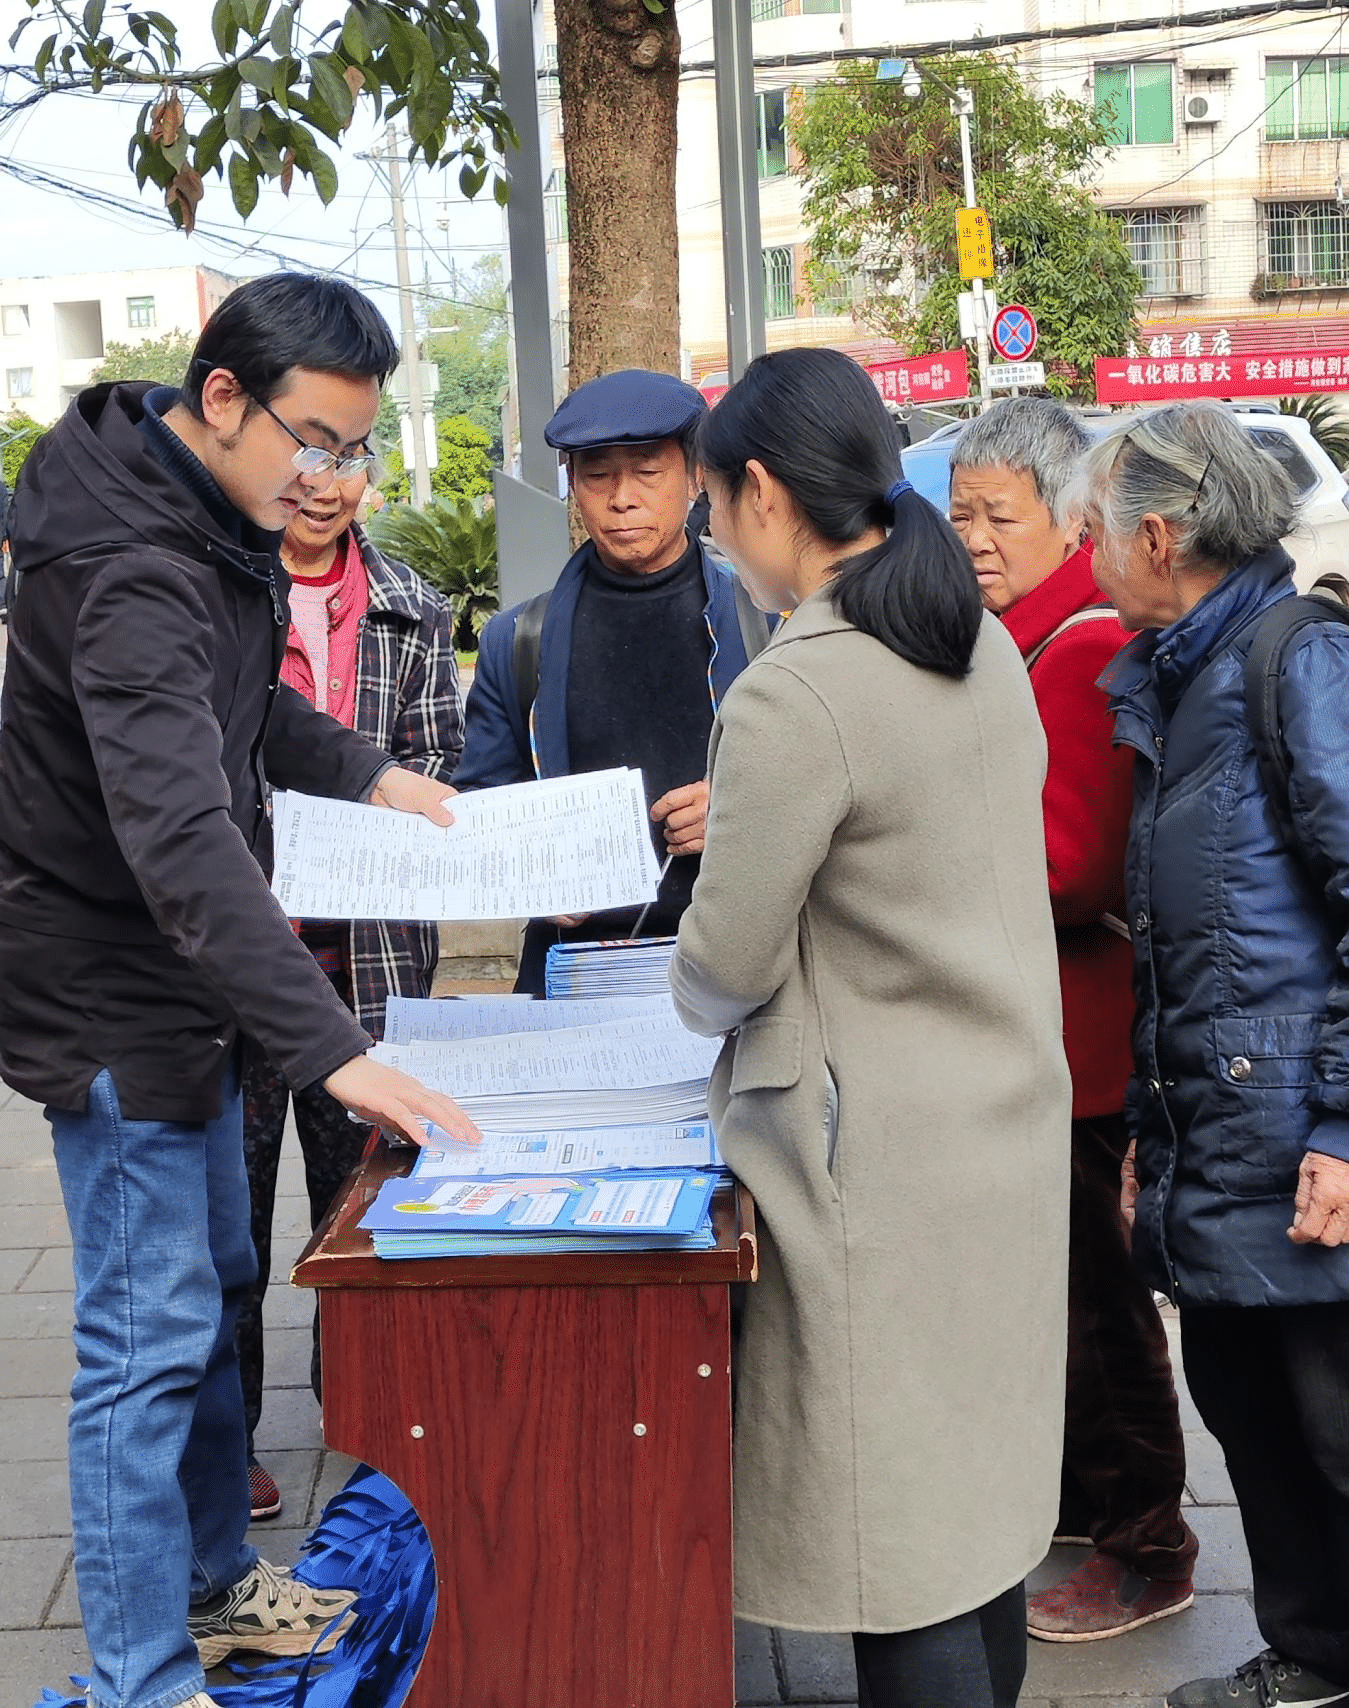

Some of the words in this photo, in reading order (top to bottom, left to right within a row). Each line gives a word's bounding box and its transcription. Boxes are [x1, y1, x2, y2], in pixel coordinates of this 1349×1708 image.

[1108, 362, 1231, 385] 一氧化碳危害大
